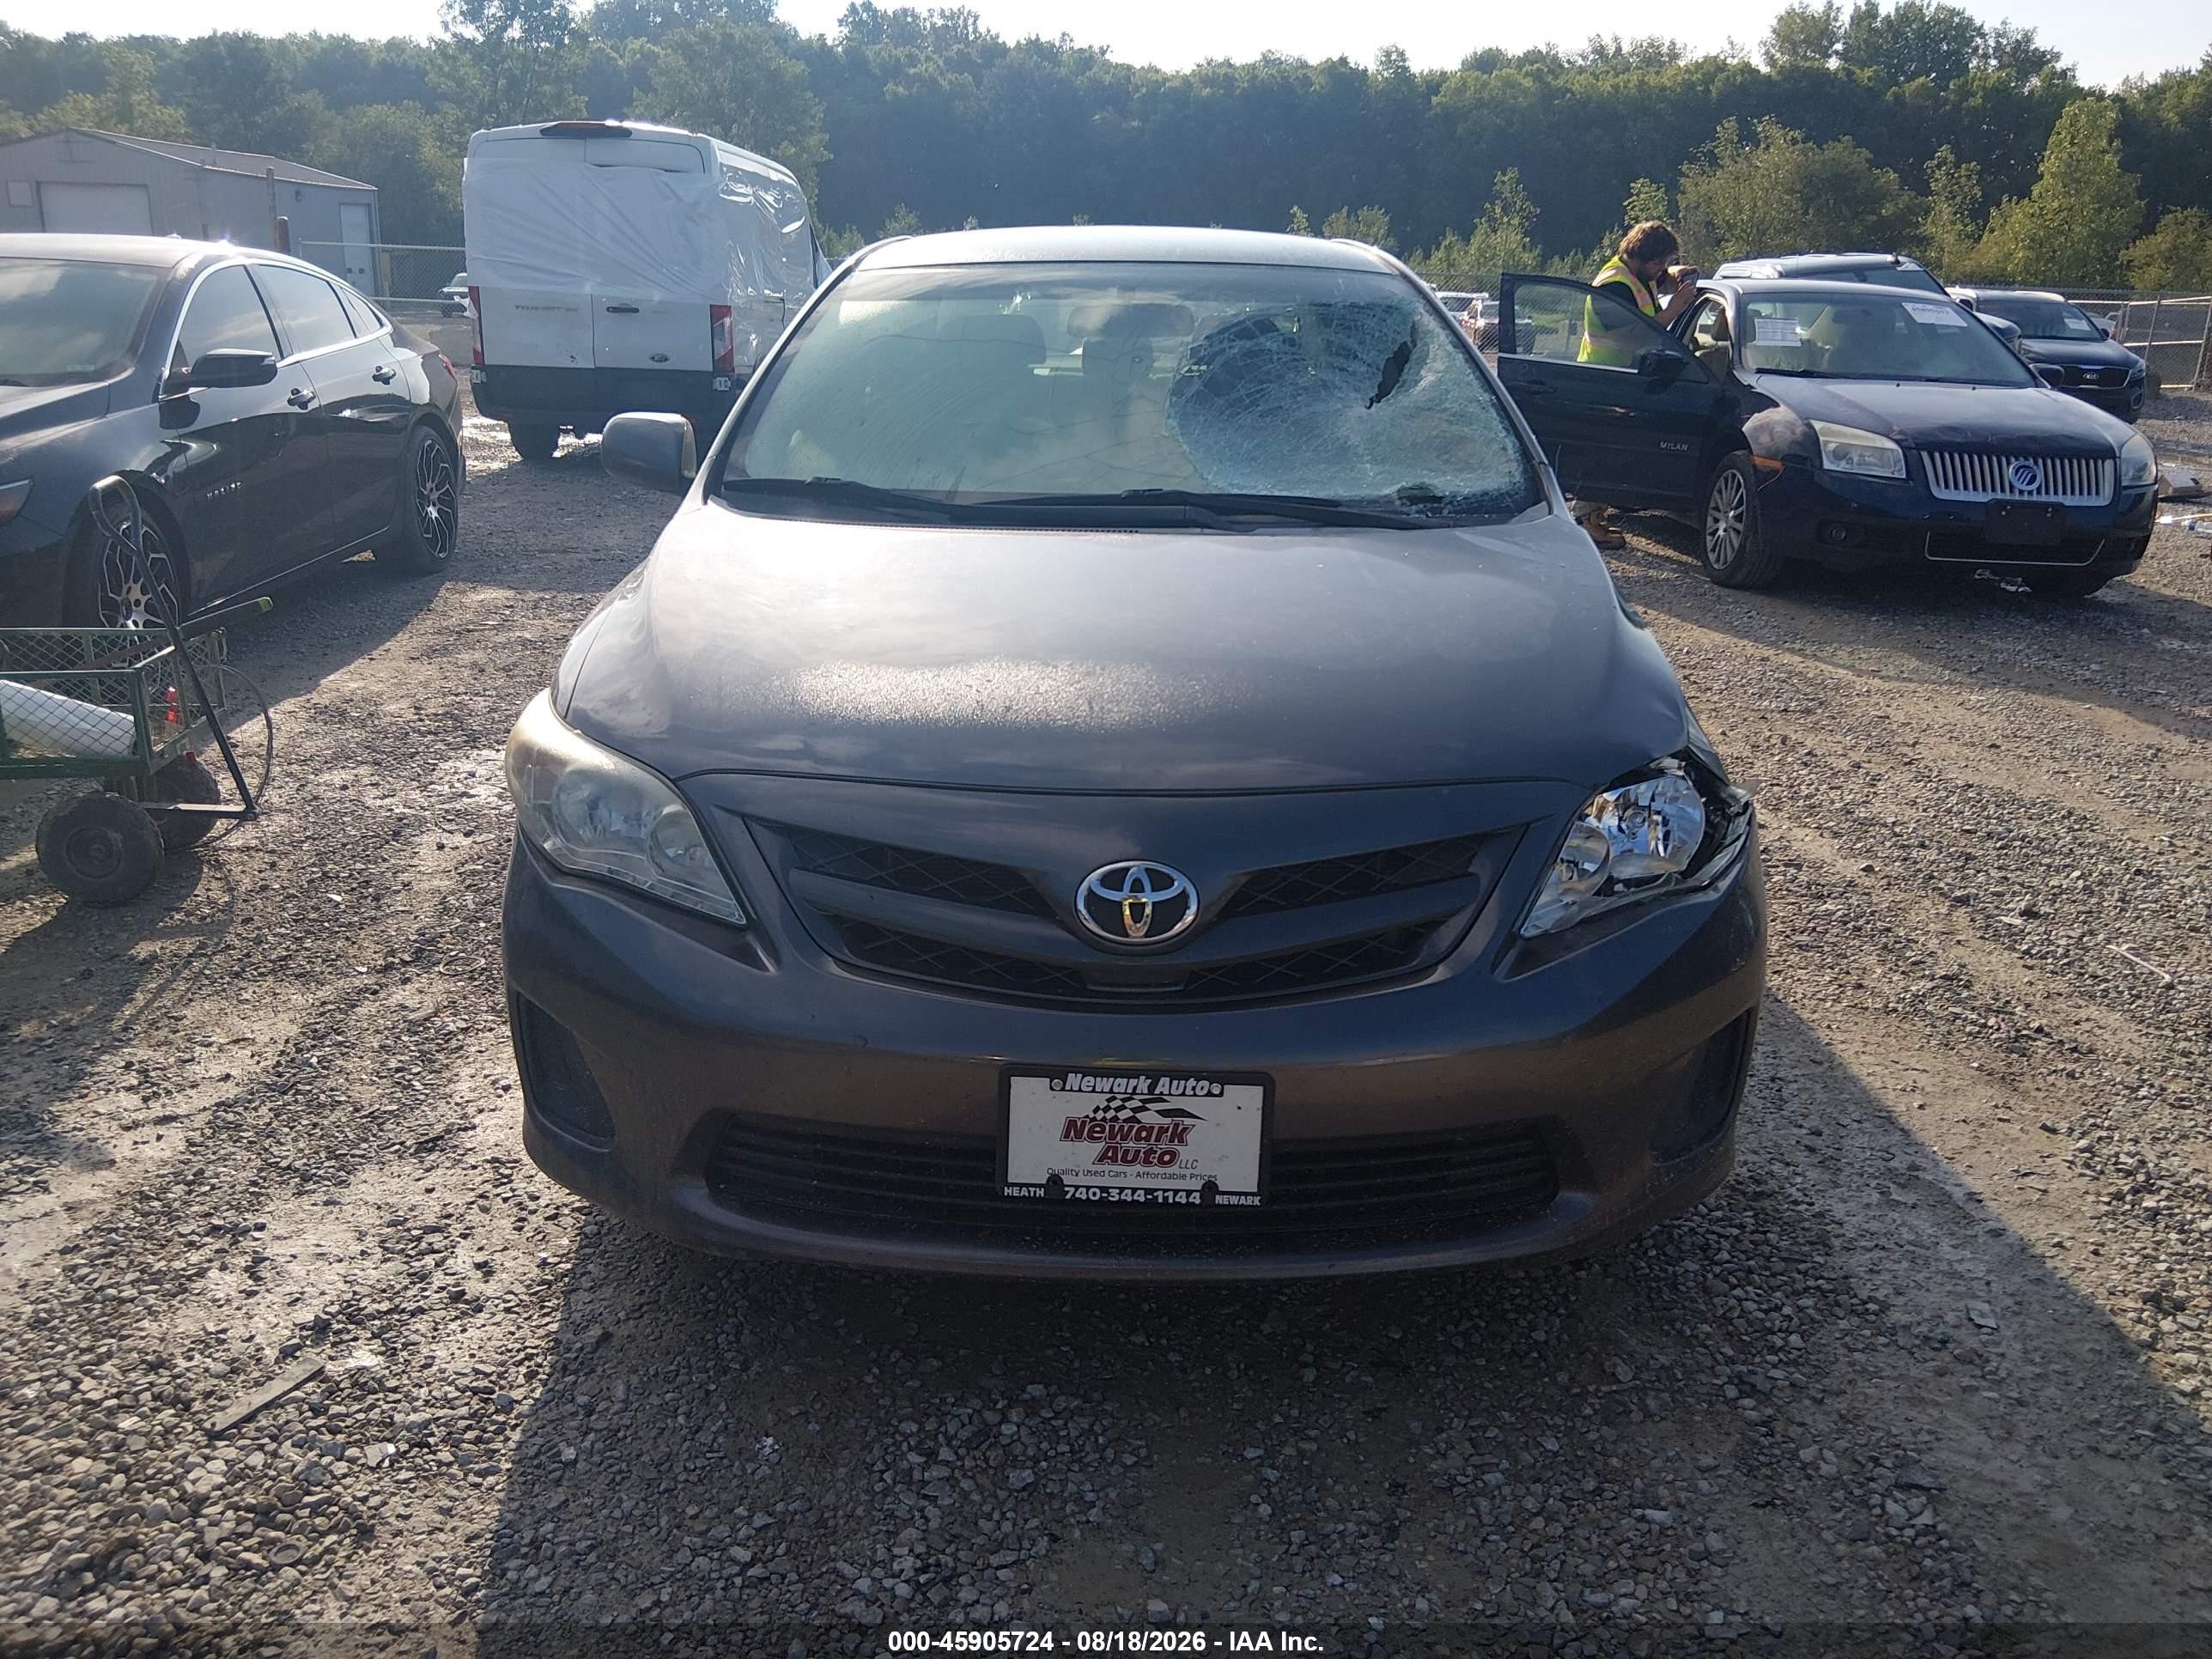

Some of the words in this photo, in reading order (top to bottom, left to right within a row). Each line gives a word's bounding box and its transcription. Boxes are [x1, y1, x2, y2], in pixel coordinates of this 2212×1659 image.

[1660, 441, 1689, 452] MILAN
[1065, 1073, 1152, 1094] Newark
[1154, 1077, 1210, 1096] Auto
[1060, 1116, 1195, 1146] Newark
[1092, 1143, 1181, 1169] Auto
[1178, 1159, 1199, 1170] LLC
[1047, 1168, 1080, 1177] Quality
[1082, 1169, 1105, 1177] Used
[1108, 1170, 1127, 1178] Cars
[1135, 1170, 1187, 1181] Affordable
[1189, 1173, 1218, 1182] Prices
[1004, 1186, 1045, 1197] HEATH
[1064, 1187, 1201, 1204] 740-344-1144
[1215, 1194, 1261, 1206] NEWARK
